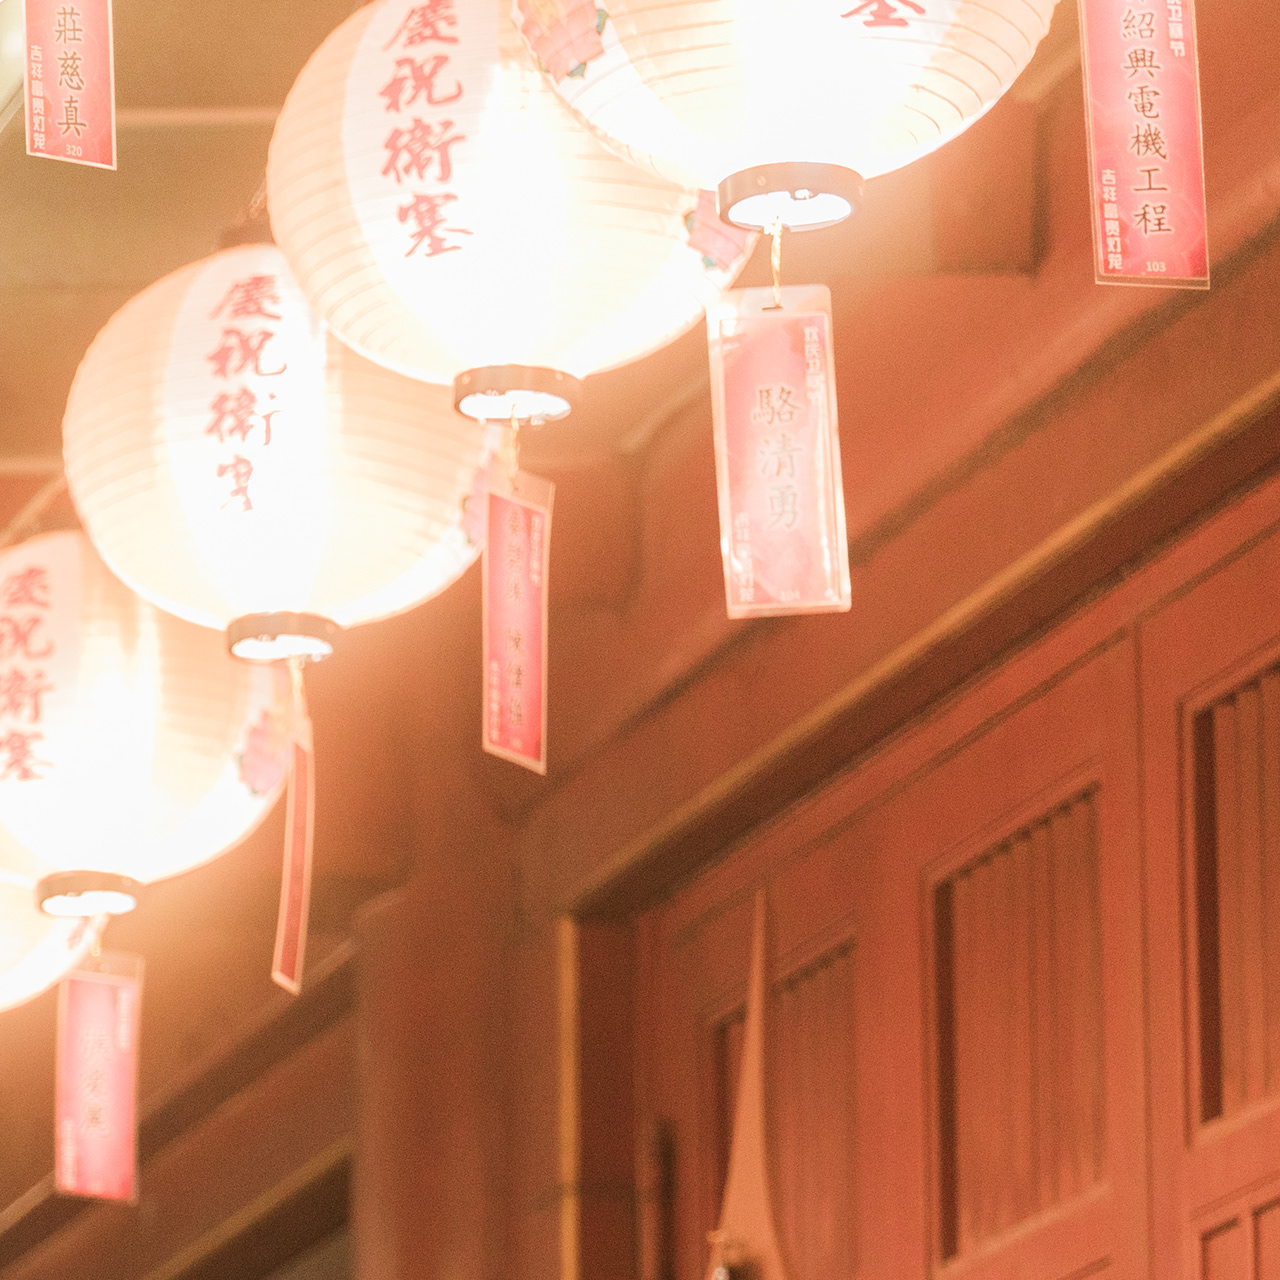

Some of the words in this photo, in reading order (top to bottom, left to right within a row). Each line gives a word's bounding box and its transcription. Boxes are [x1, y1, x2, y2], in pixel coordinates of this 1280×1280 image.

[54, 6, 88, 138] 莊慈真
[65, 143, 82, 157] 320
[1146, 261, 1166, 273] 103
